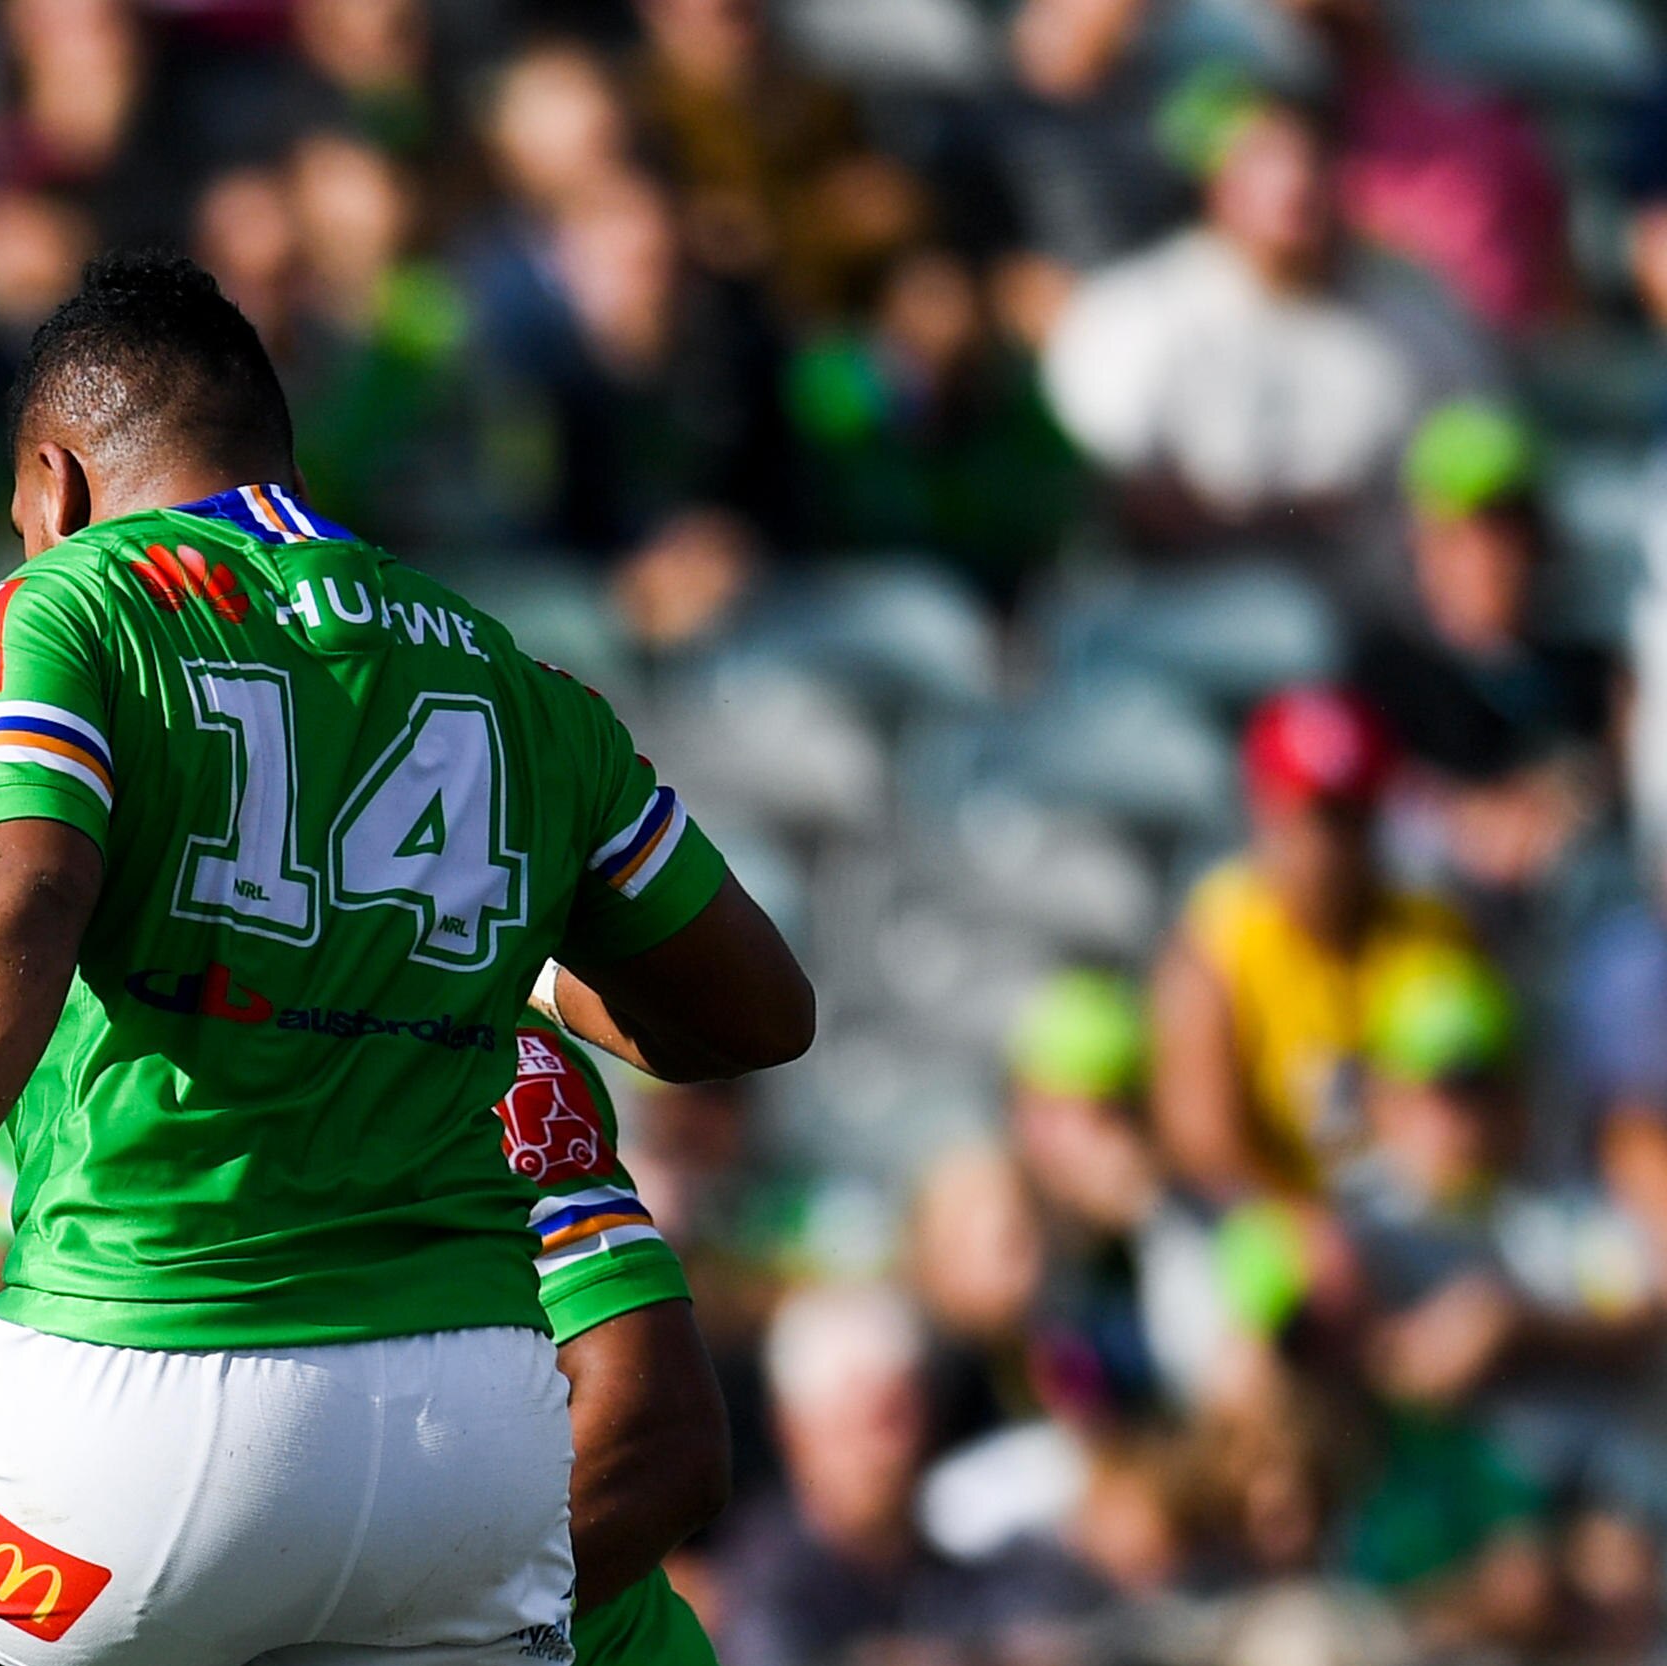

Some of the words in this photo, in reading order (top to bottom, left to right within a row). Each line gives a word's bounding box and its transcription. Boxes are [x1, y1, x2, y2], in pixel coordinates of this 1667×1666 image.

[171, 657, 528, 971] 14
[233, 877, 271, 902] NRL
[439, 913, 469, 938] NRL
